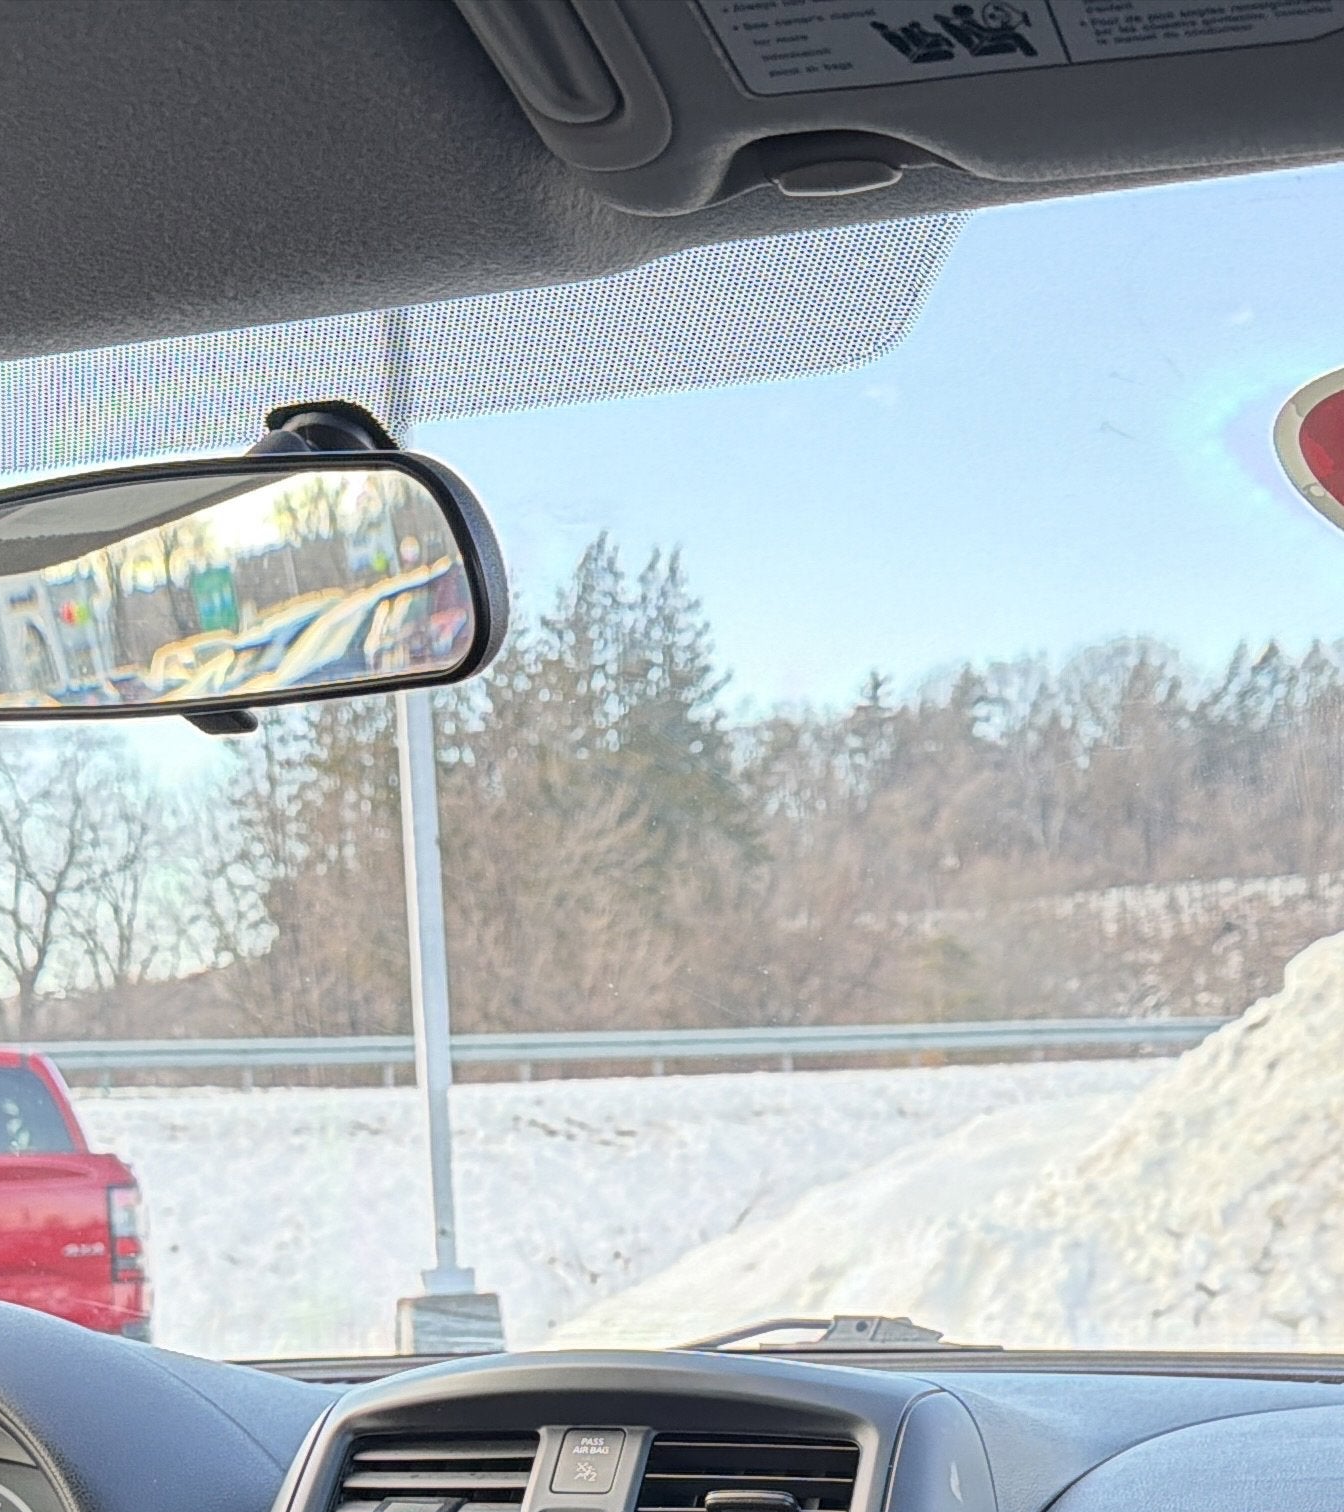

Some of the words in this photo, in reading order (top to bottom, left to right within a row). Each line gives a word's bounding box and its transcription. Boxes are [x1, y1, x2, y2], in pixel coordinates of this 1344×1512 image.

[580, 1437, 605, 1446] PASS
[573, 1446, 588, 1455] AIR
[589, 1446, 610, 1455] BAG
